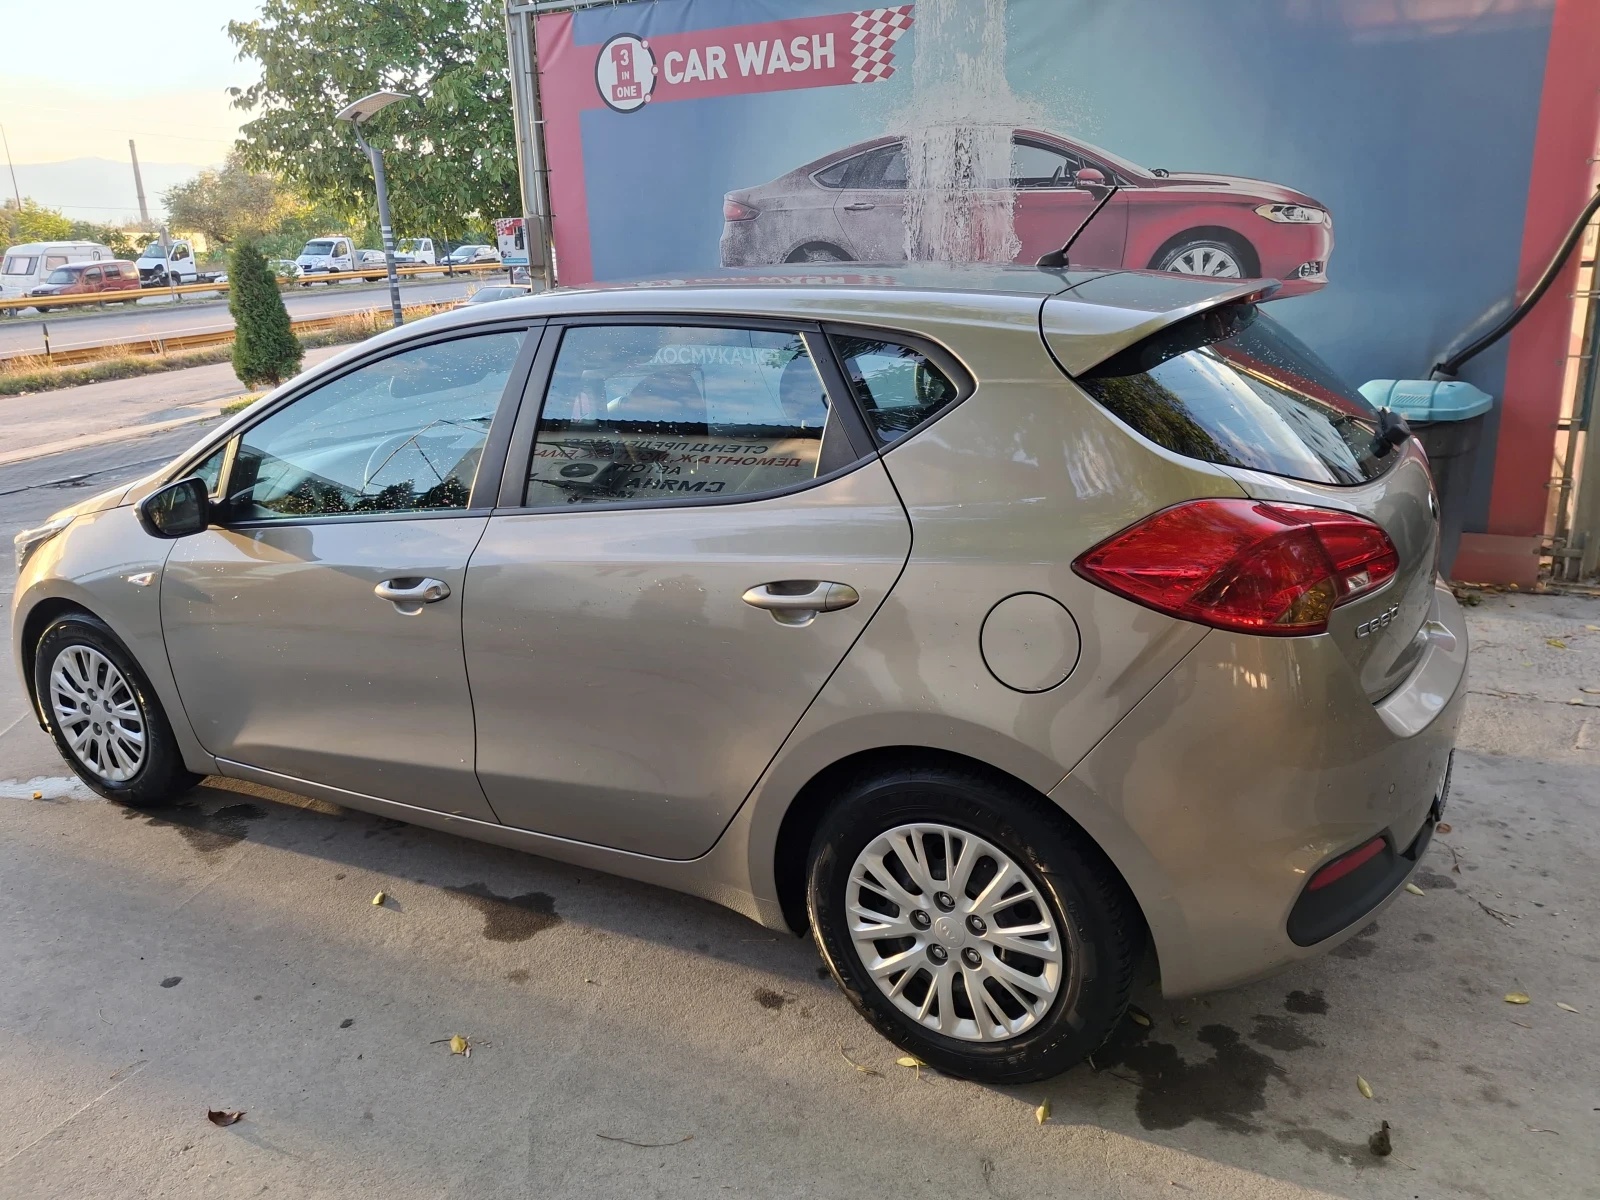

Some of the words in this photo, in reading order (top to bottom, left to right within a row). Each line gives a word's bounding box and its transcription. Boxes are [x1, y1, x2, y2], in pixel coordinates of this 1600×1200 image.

[620, 49, 629, 66] 3
[663, 46, 728, 85] CAR
[734, 32, 836, 77] WASH
[621, 71, 630, 80] IN
[616, 85, 638, 98] ONE
[653, 347, 779, 365] ХОСМУКАЧК
